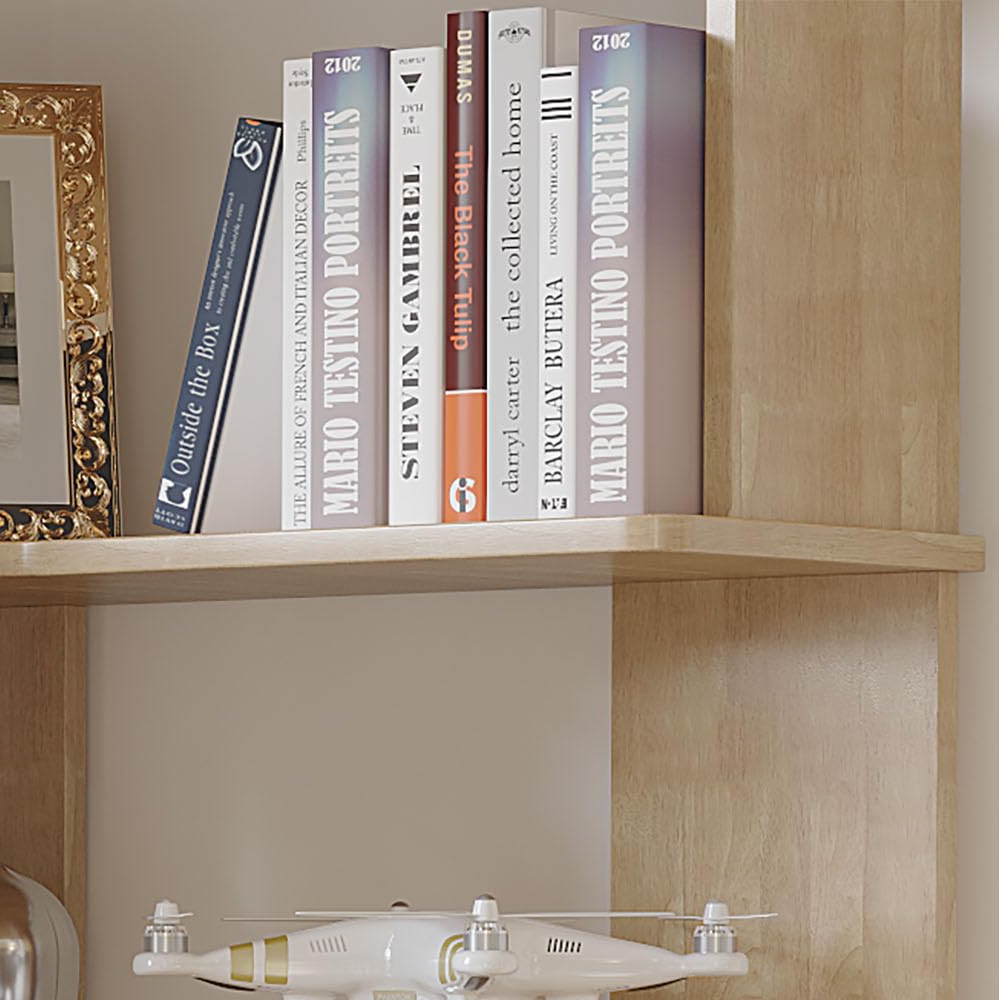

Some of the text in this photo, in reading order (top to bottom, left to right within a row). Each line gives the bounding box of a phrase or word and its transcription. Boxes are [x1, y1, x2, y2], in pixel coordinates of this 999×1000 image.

[324, 56, 361, 74] 2012
[456, 29, 473, 104] DUMAS
[592, 32, 631, 51] 2012
[297, 119, 309, 162] Phillips
[402, 127, 421, 135] TIME
[450, 145, 473, 350] The Black Tulip
[501, 82, 522, 331] the collected home
[550, 134, 559, 256] LIVING ON THE COAST
[294, 180, 308, 527] THE ALLURE OF FRENCH AND ITALIAN DECOR
[323, 286, 360, 409] TESTINO
[402, 165, 420, 480] STEVEN GAMBREL
[544, 278, 564, 368] BUTERA
[590, 269, 628, 393] TESTINO
[170, 322, 221, 475] Outside the Box
[502, 357, 525, 493] darryl carter
[544, 383, 563, 484] BARCLAY
[590, 403, 627, 503] MARIO
[323, 417, 360, 516] MARIO
